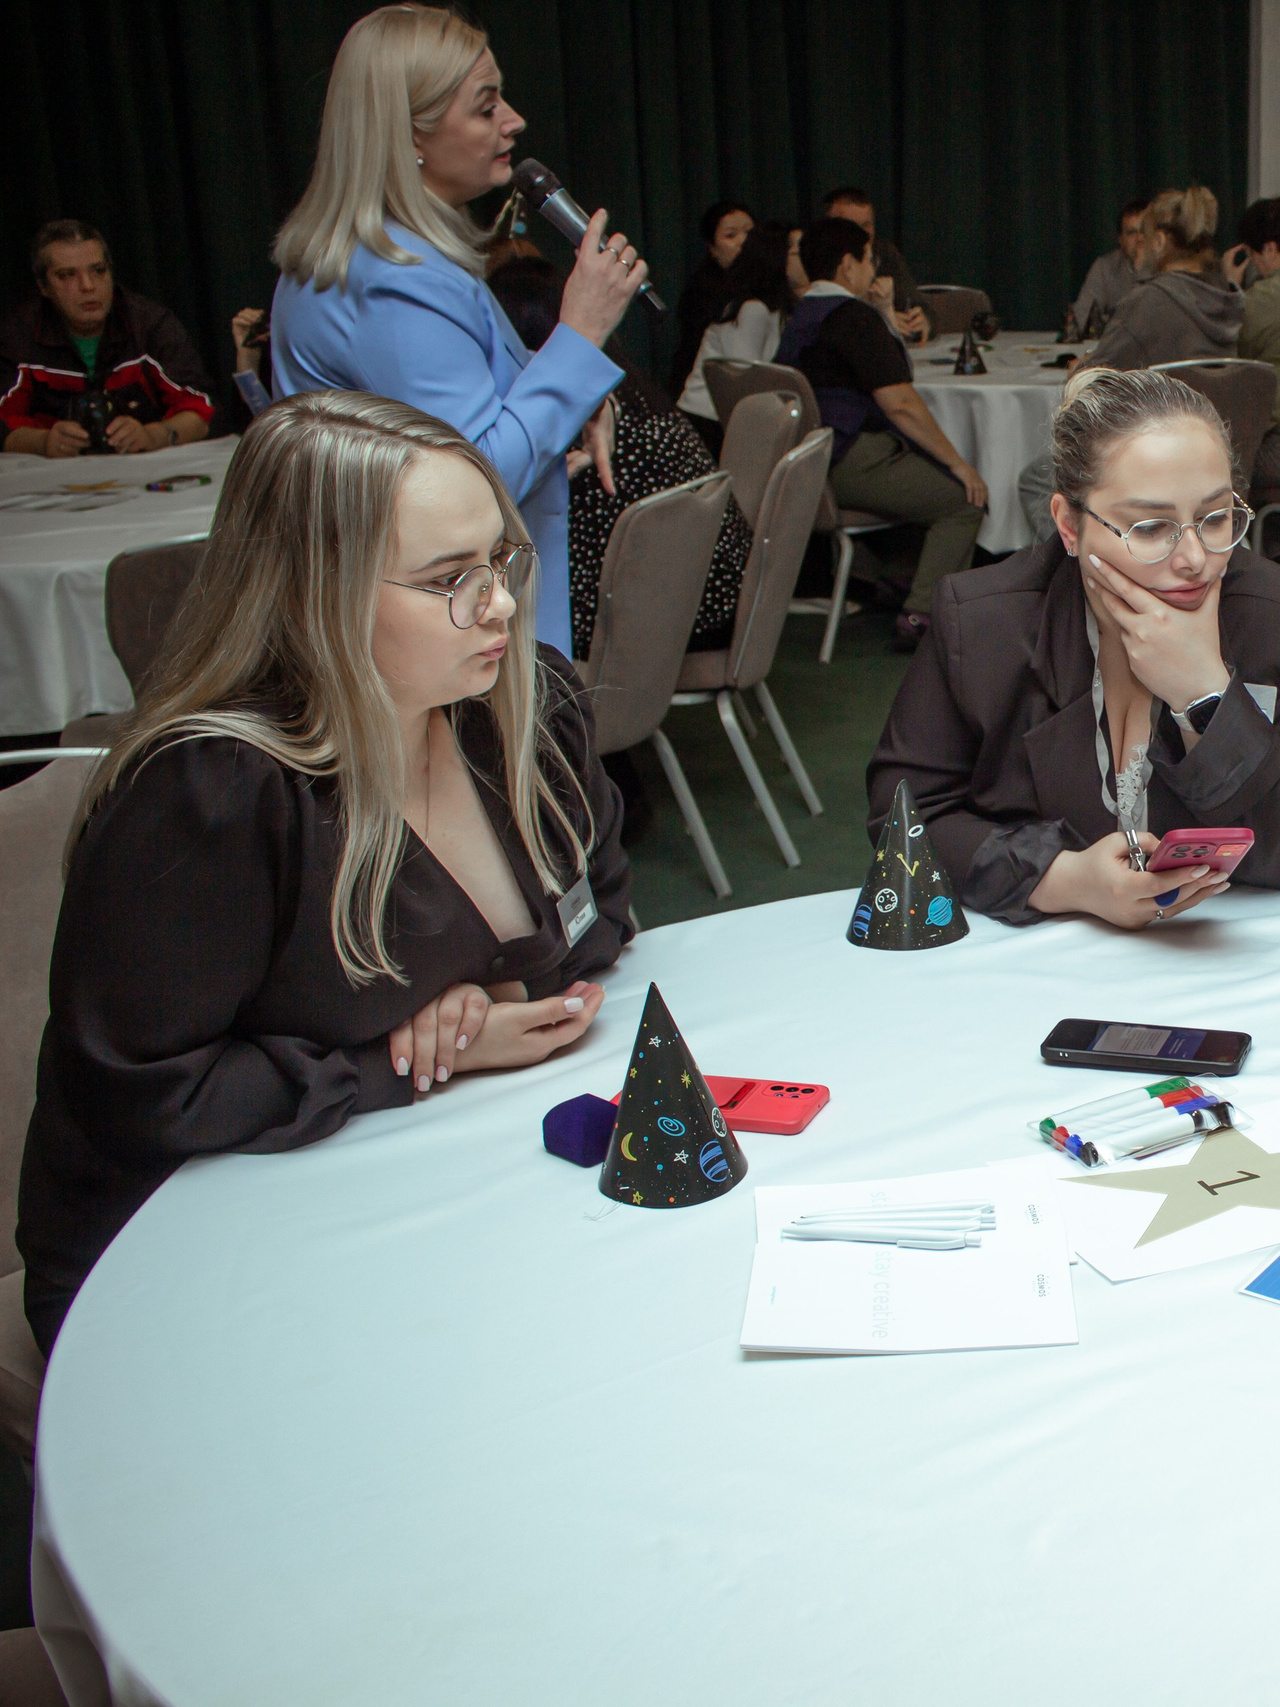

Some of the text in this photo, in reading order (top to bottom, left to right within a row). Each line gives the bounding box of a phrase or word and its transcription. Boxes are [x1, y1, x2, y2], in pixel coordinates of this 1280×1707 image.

[1197, 1170, 1261, 1196] 1
[1028, 1204, 1040, 1225] COSMOS
[868, 1250, 895, 1339] stay creative
[1036, 1273, 1046, 1298] COSMOS
